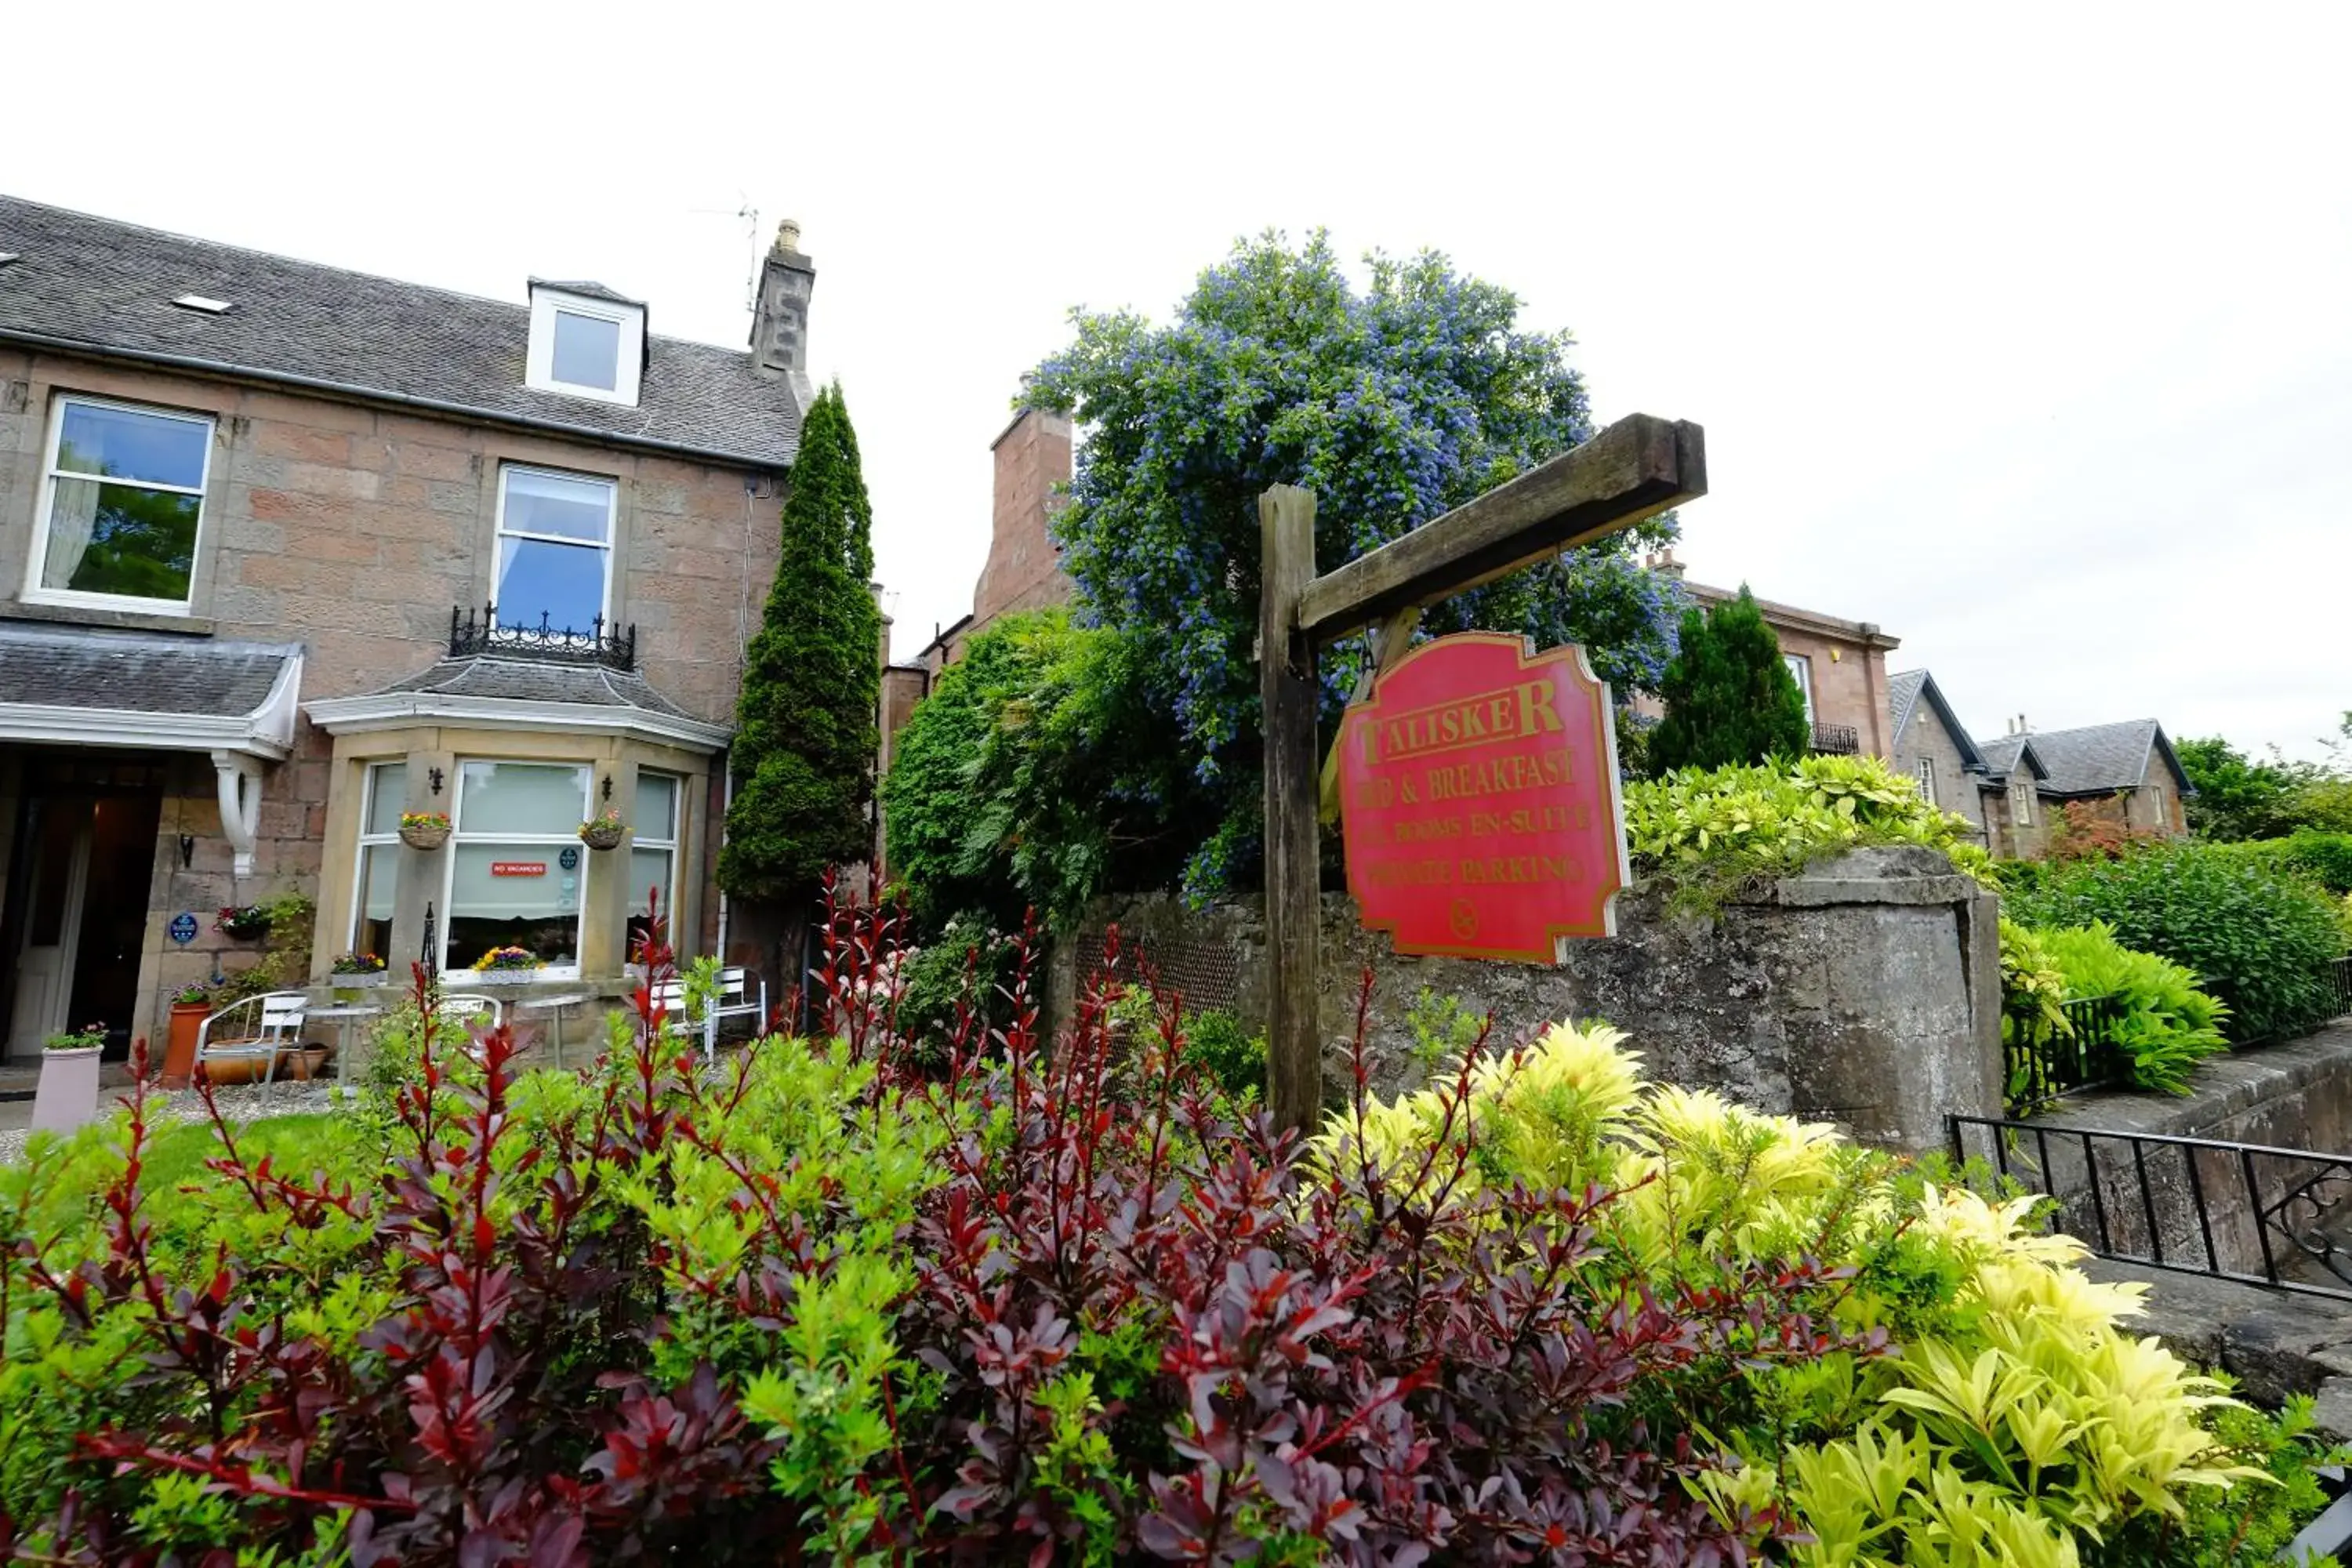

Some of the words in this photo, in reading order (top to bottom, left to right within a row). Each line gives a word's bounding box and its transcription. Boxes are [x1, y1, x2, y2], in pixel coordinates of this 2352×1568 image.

[1360, 679, 1565, 766] TALISKER
[1400, 770, 1420, 804] &
[1426, 748, 1574, 801] BREAKFAST
